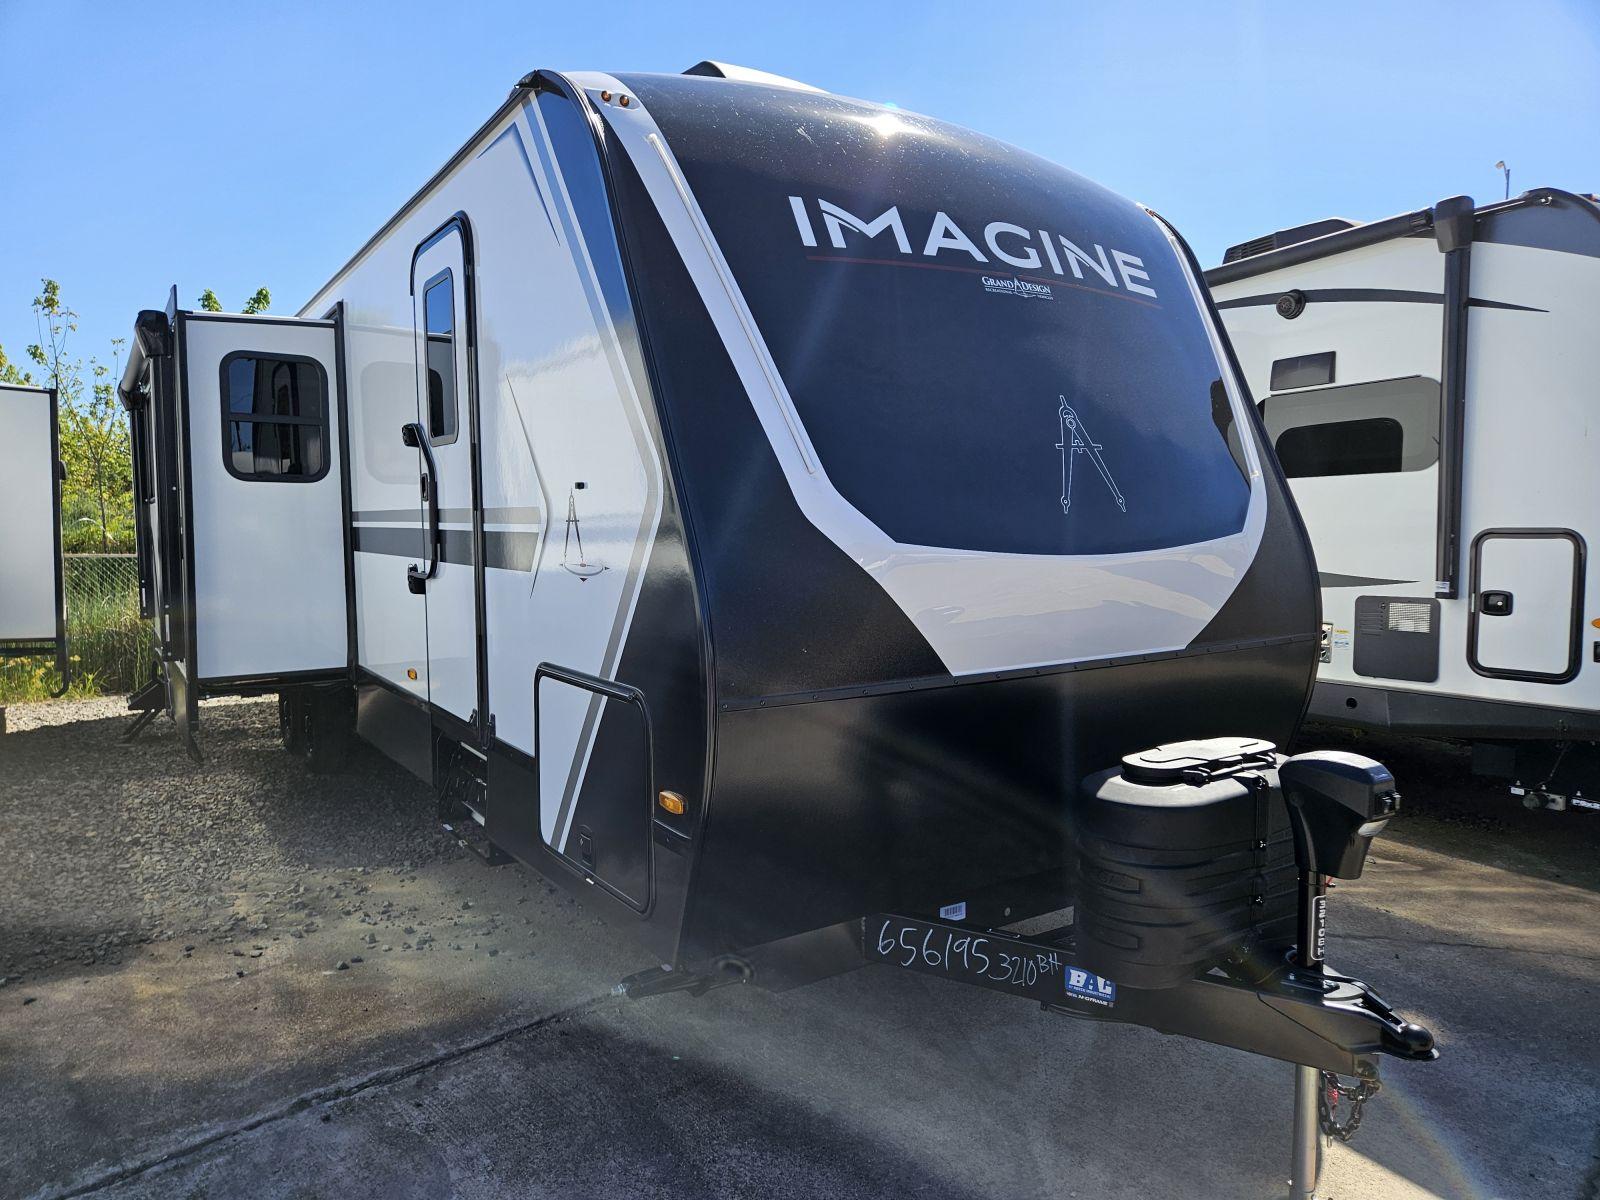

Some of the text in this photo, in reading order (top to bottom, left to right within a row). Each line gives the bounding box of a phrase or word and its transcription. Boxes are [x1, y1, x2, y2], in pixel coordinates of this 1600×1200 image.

[788, 195, 1158, 299] IMAGINE
[981, 276, 1051, 293] GRAND DESIGN
[877, 920, 989, 974] 656195
[1068, 969, 1112, 995] BAL
